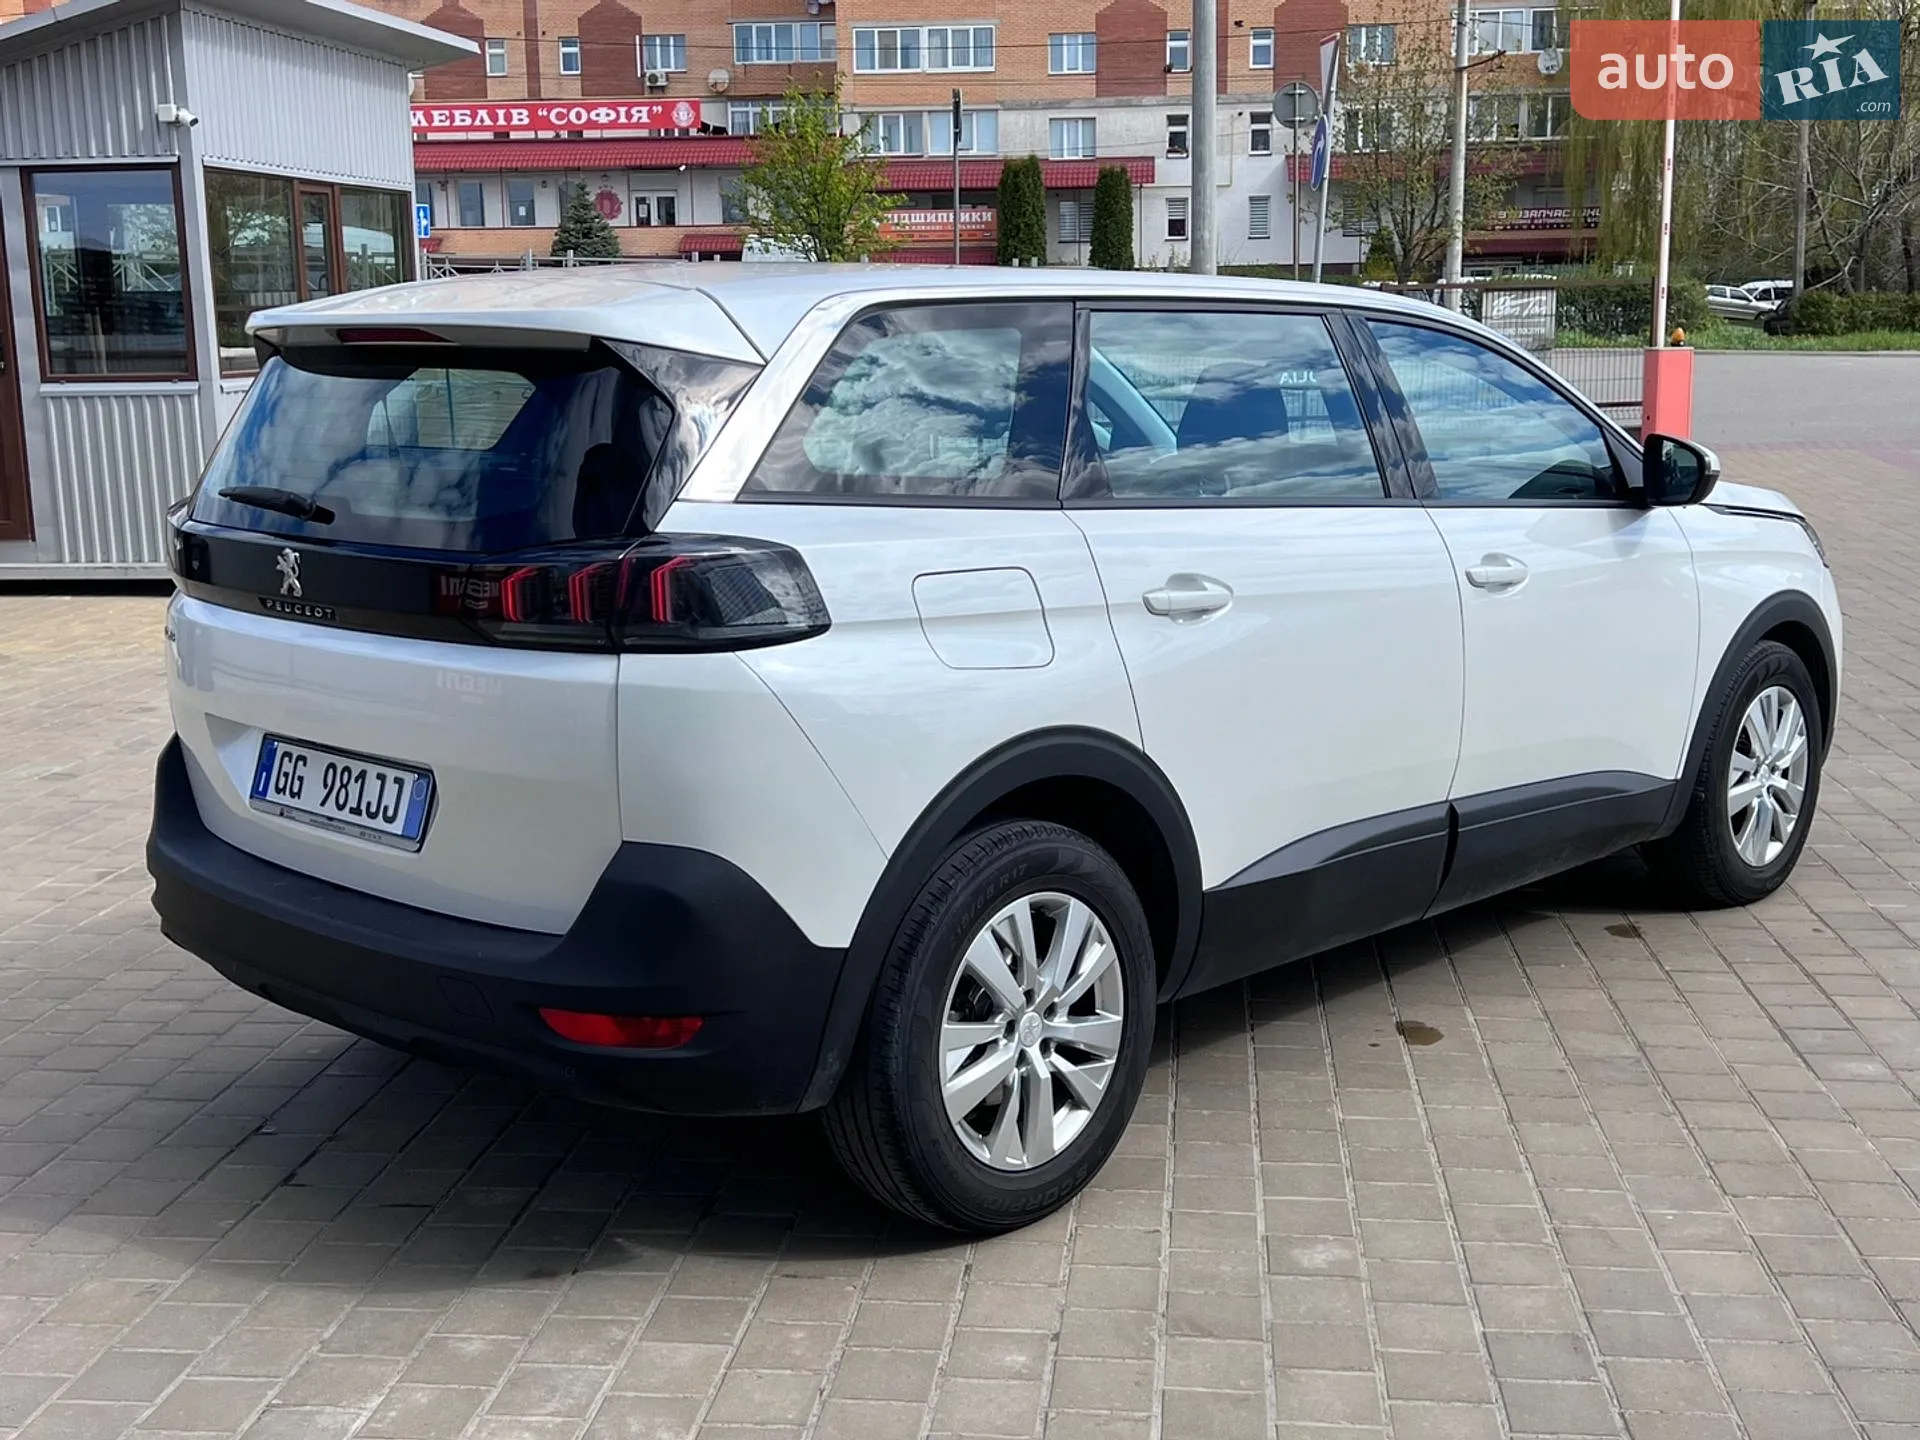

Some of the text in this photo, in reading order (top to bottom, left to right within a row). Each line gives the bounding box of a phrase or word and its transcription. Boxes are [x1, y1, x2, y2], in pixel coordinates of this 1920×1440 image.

[266, 599, 333, 619] PEUGEOT
[274, 750, 405, 824] GG 981JJ
